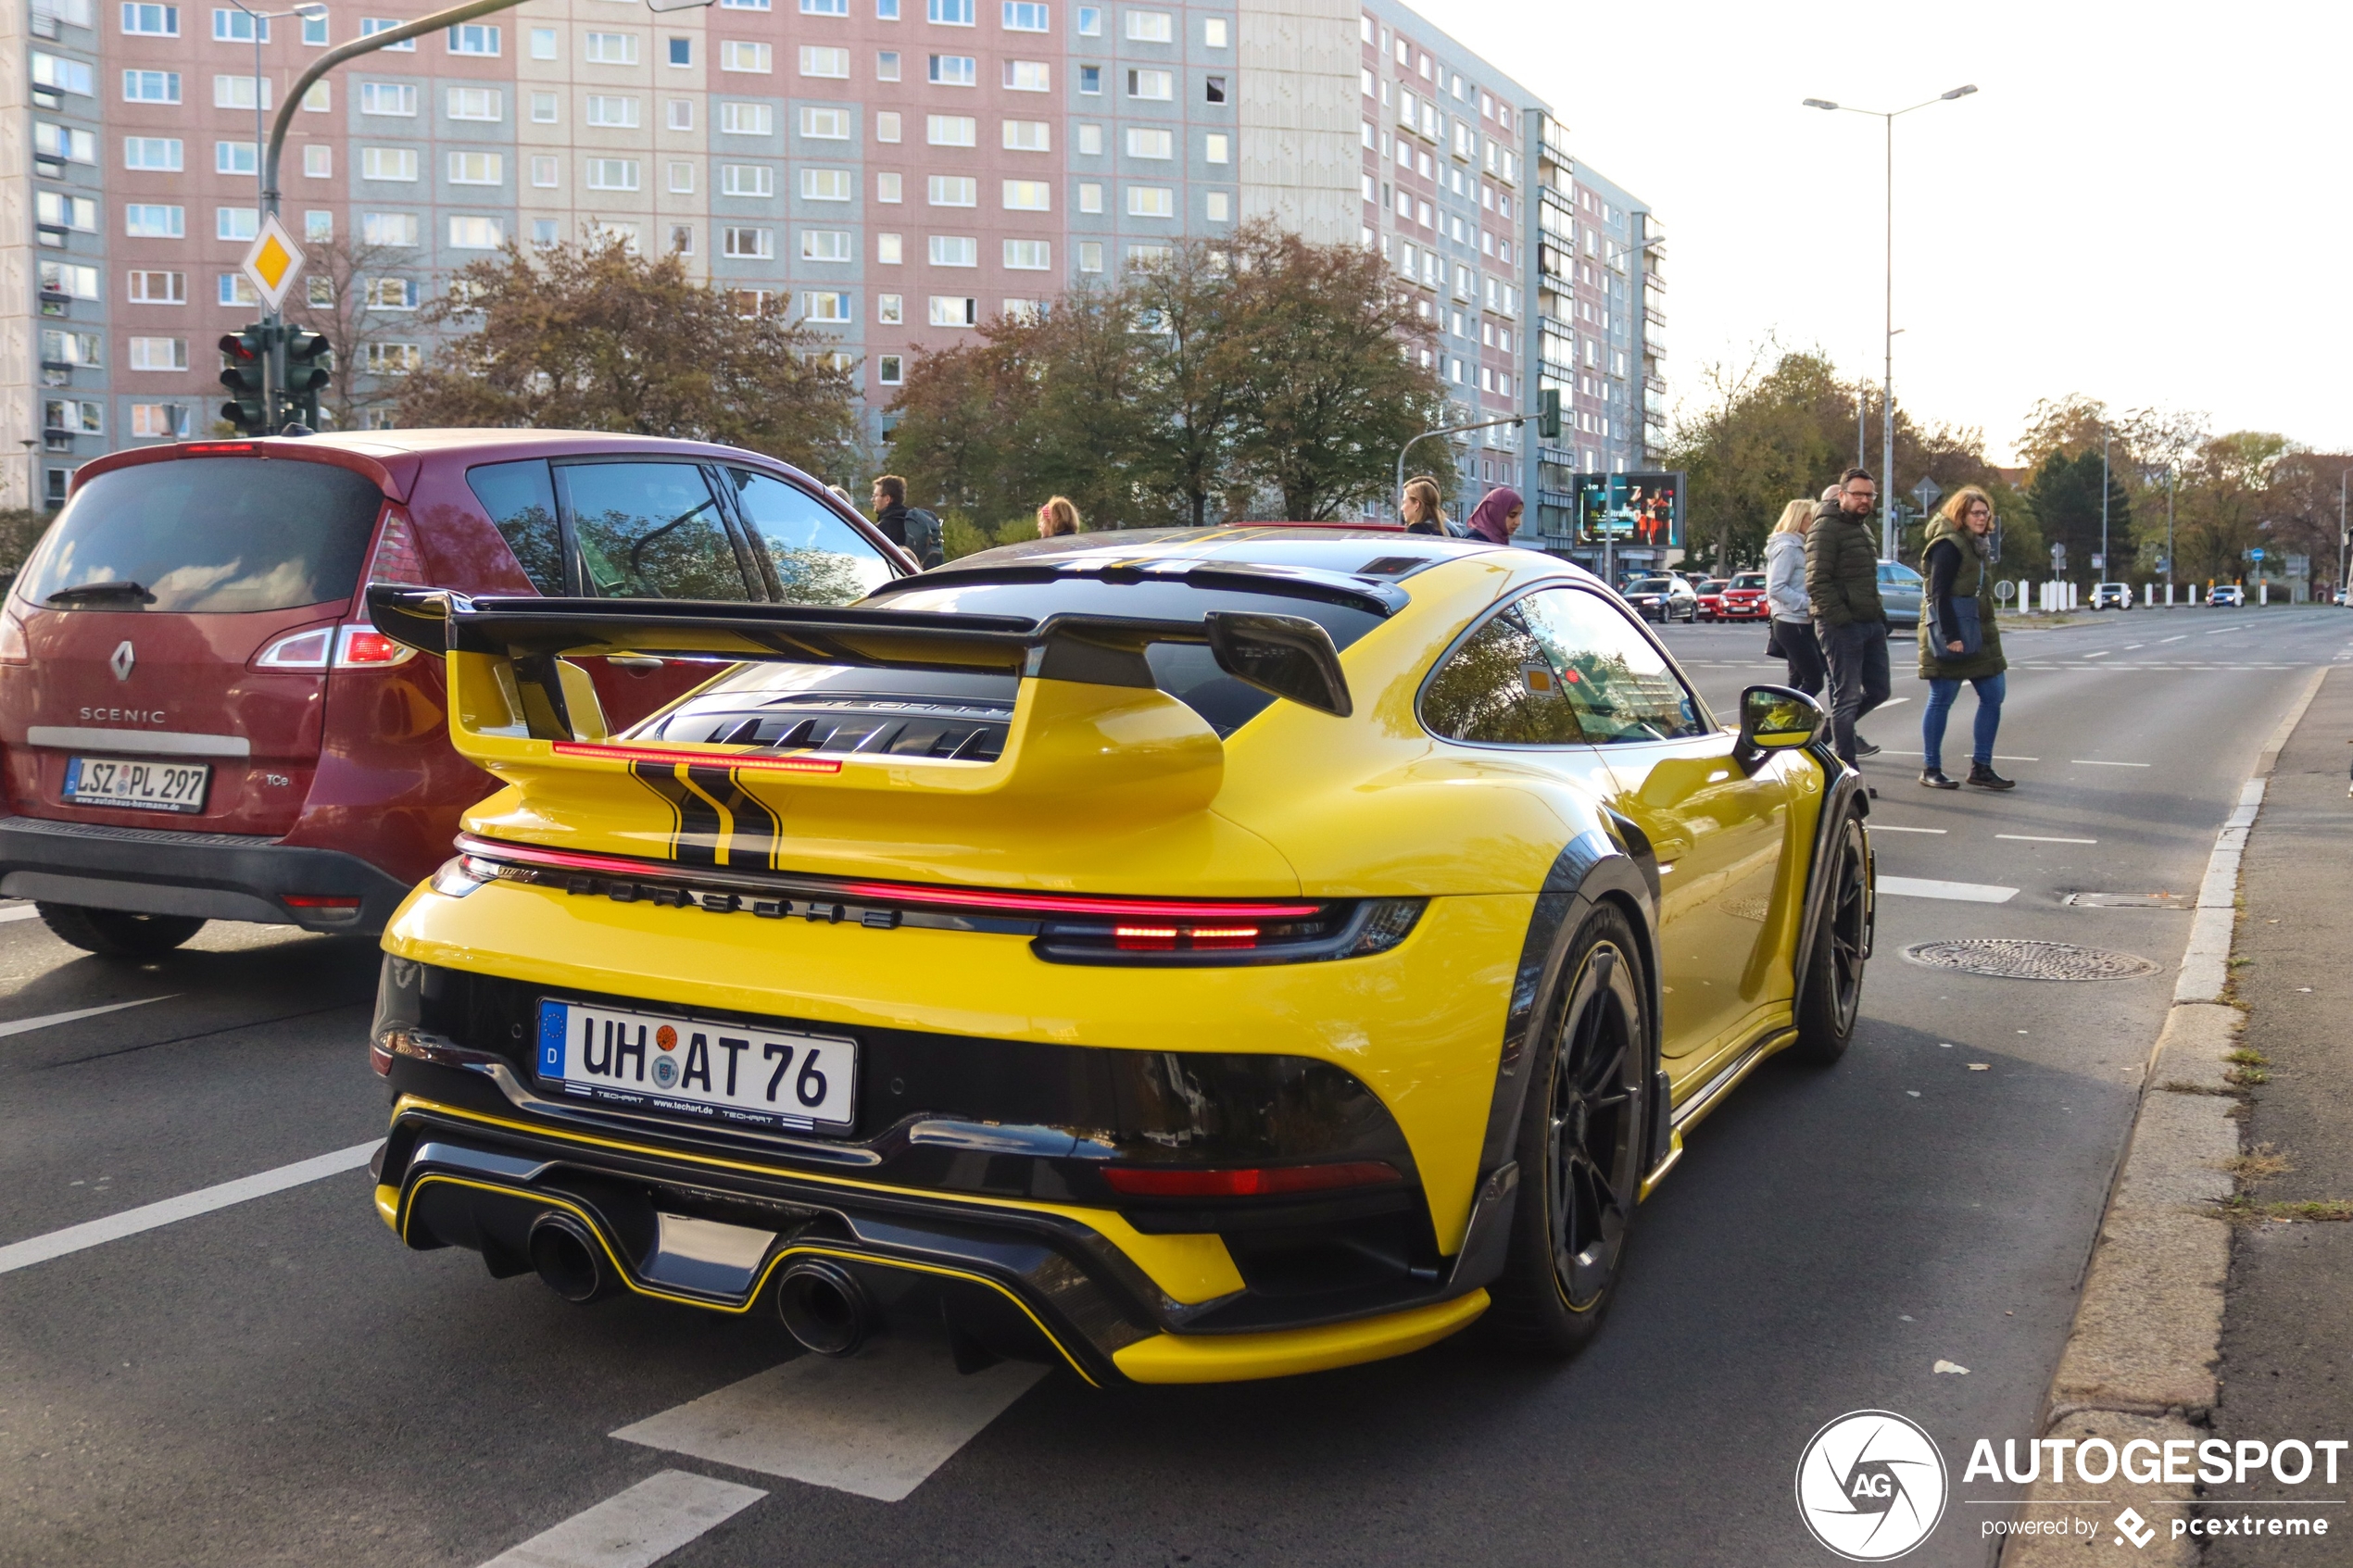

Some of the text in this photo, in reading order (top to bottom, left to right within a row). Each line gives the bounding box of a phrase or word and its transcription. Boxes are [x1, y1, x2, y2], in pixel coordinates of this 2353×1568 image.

[80, 708, 166, 723] SCENIC
[77, 763, 117, 794] LSZ
[129, 766, 154, 797] PL
[160, 769, 204, 800] 297
[266, 773, 289, 786] TCe
[76, 797, 180, 811] www.autohaus-hermann.de
[566, 876, 901, 929] PORSCHE
[547, 1047, 558, 1064] D
[584, 1017, 647, 1082] UH
[681, 1032, 749, 1097] AT
[763, 1043, 827, 1108] 76
[597, 1090, 774, 1123] TECHART www.techart.de TECHART
